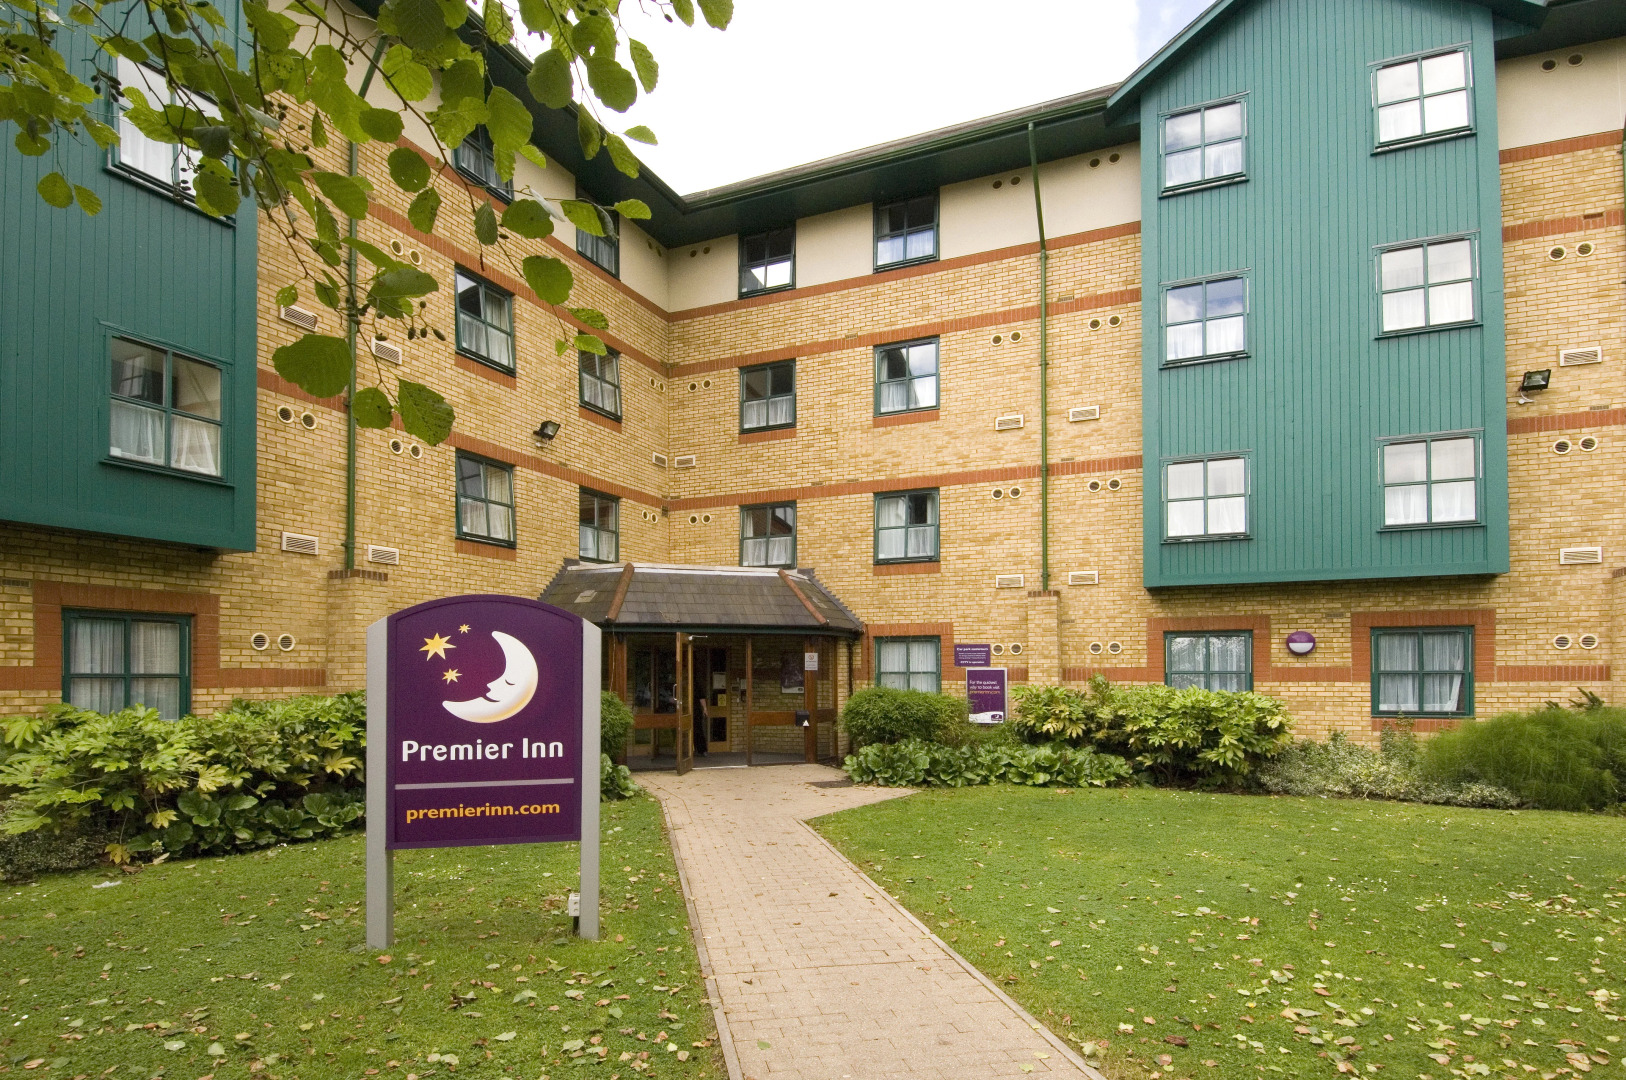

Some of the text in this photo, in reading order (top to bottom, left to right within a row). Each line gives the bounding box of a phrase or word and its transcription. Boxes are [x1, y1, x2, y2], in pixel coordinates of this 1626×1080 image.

[402, 738, 564, 762] Premier Inn
[406, 803, 560, 824] premierinn.com
